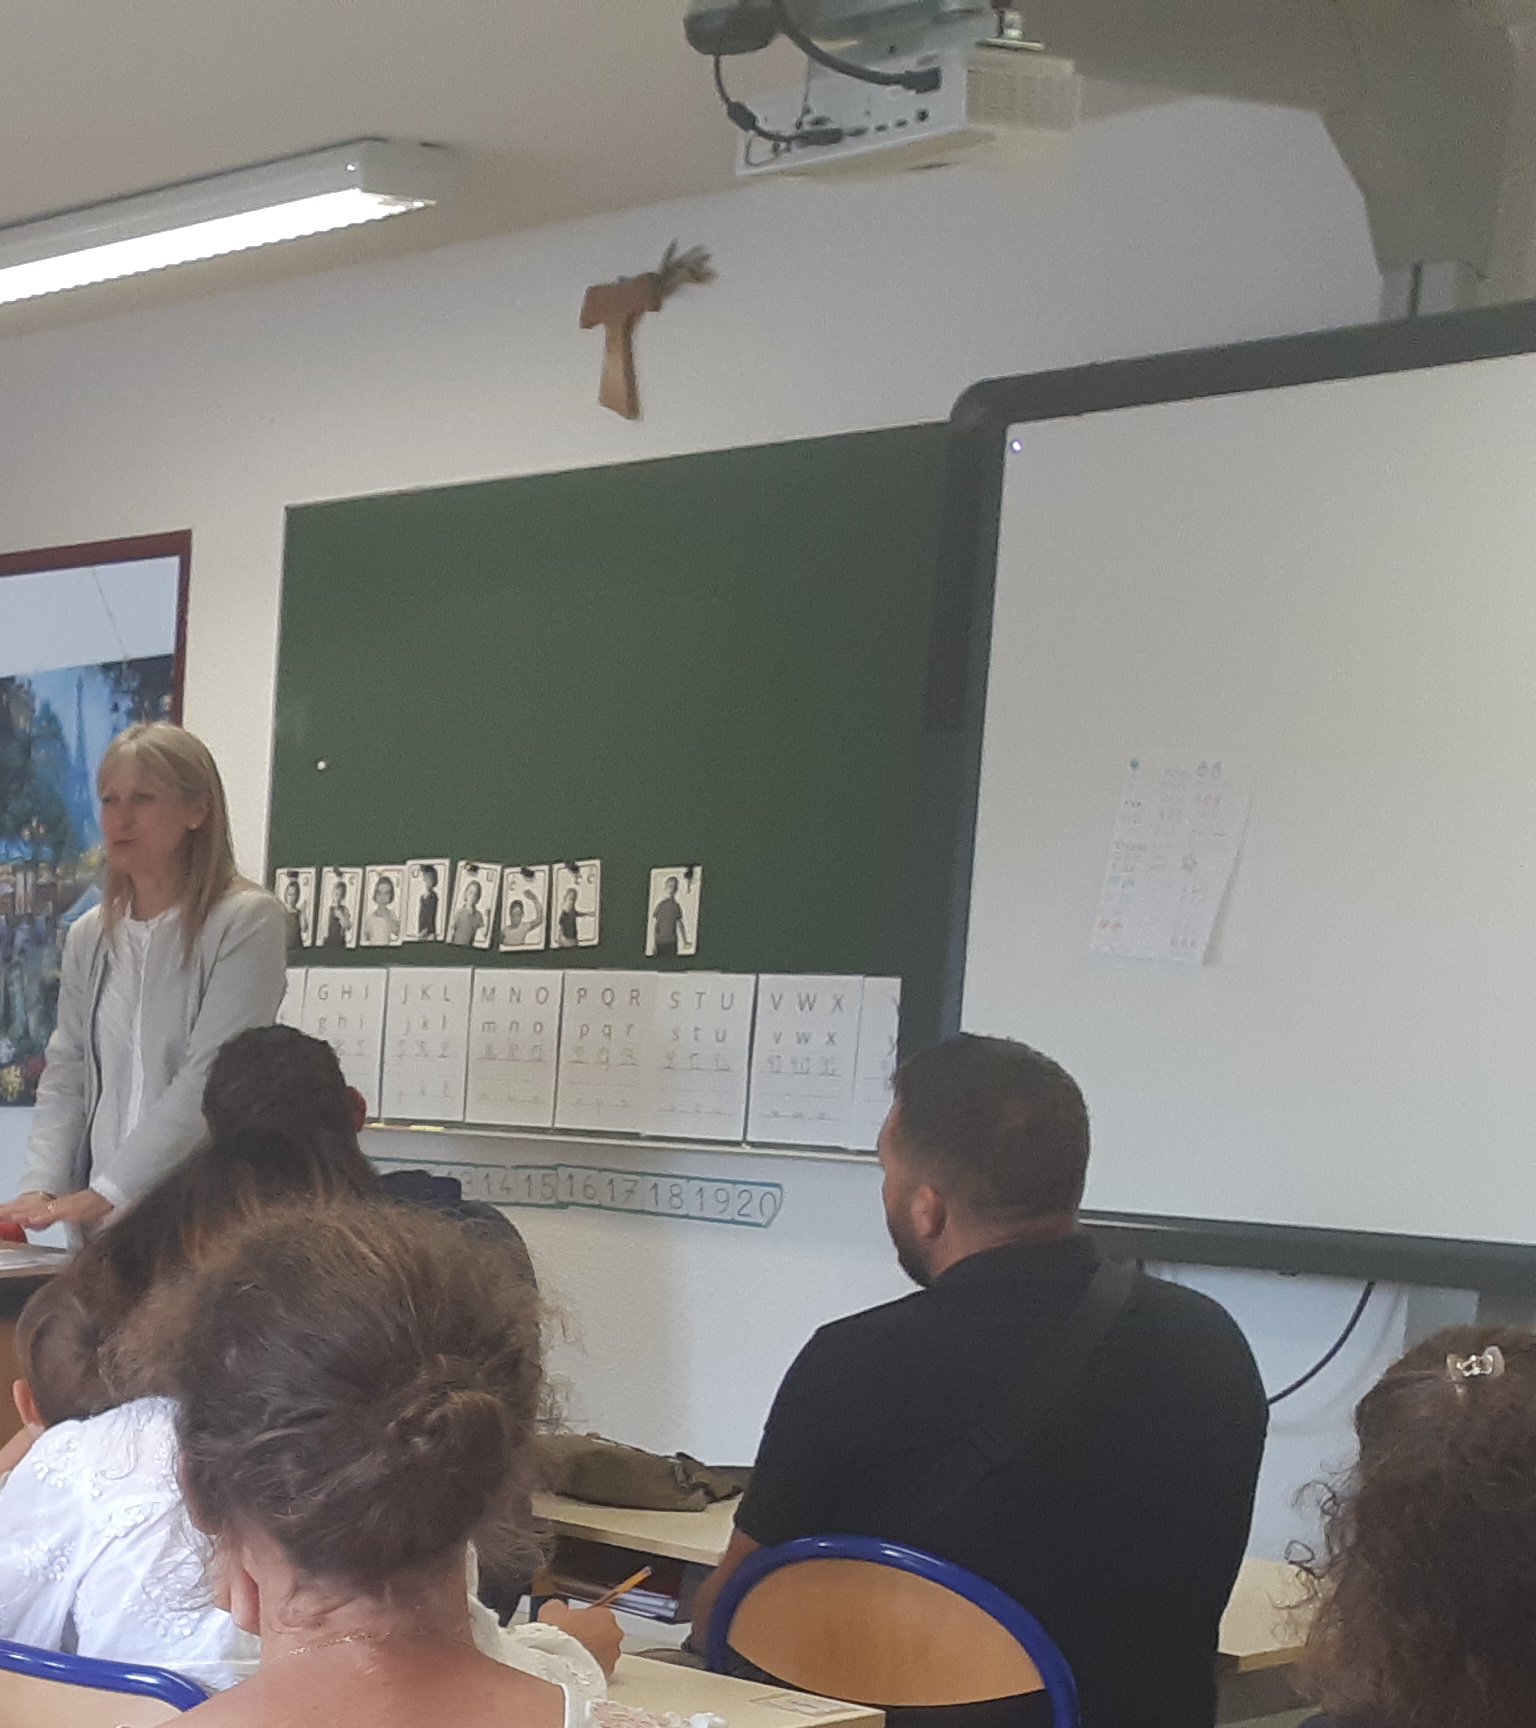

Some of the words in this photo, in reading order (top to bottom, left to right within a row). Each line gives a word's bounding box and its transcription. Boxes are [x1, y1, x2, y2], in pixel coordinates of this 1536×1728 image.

[318, 984, 329, 1001] G
[341, 984, 352, 1000] H
[421, 984, 432, 1001] K
[443, 985, 451, 1002] L
[481, 986, 496, 1003] M
[508, 986, 521, 1003] N
[535, 986, 549, 1005] O
[576, 987, 588, 1004] P
[601, 987, 616, 1009] Q
[629, 988, 641, 1006] R
[670, 991, 680, 1010] S
[695, 991, 707, 1010] T
[720, 992, 735, 1011] U
[770, 993, 783, 1011] V
[797, 993, 817, 1012] W
[831, 993, 844, 1013] X
[481, 1021, 496, 1034] m
[508, 1021, 520, 1034] n
[532, 1021, 544, 1035] o
[579, 1024, 590, 1040] p
[601, 1024, 612, 1041] q
[714, 1030, 727, 1044] u
[795, 1031, 812, 1045] w
[825, 1031, 838, 1046] x
[483, 1172, 513, 1197] 14
[524, 1173, 555, 1200] 15
[566, 1173, 598, 1200] 16
[606, 1177, 637, 1203] 17
[649, 1182, 685, 1210] 18
[695, 1187, 731, 1214] 19
[735, 1188, 777, 1218] 20
